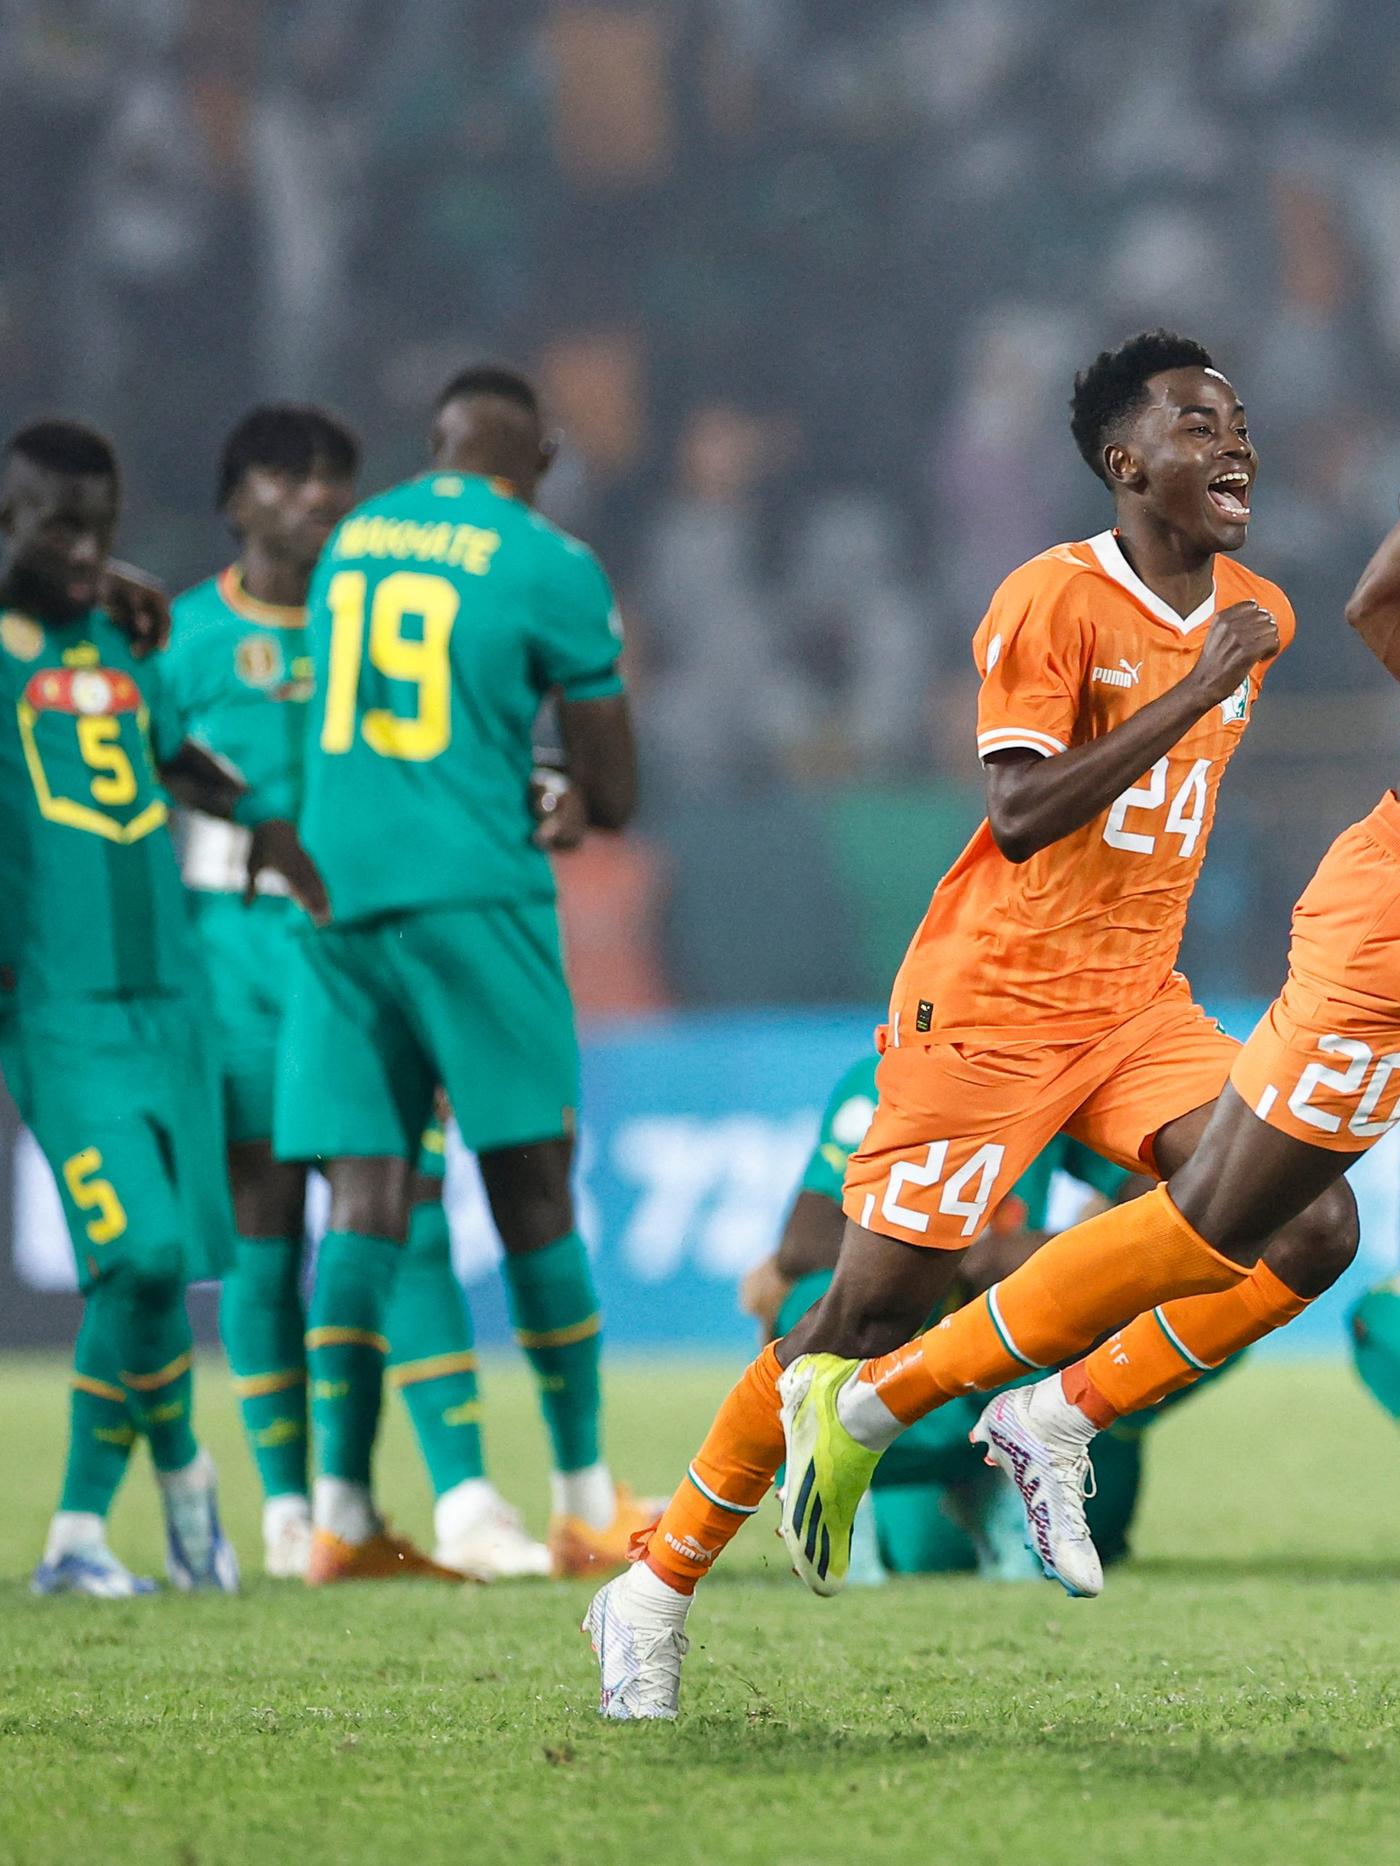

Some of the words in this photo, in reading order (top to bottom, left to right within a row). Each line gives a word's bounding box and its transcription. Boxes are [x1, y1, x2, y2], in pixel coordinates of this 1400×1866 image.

[320, 569, 459, 761] 19
[1092, 666, 1132, 689] PUMA
[77, 713, 137, 806] 5
[1102, 756, 1211, 858] 24
[63, 1147, 127, 1244] 5
[883, 1139, 1006, 1236] 24
